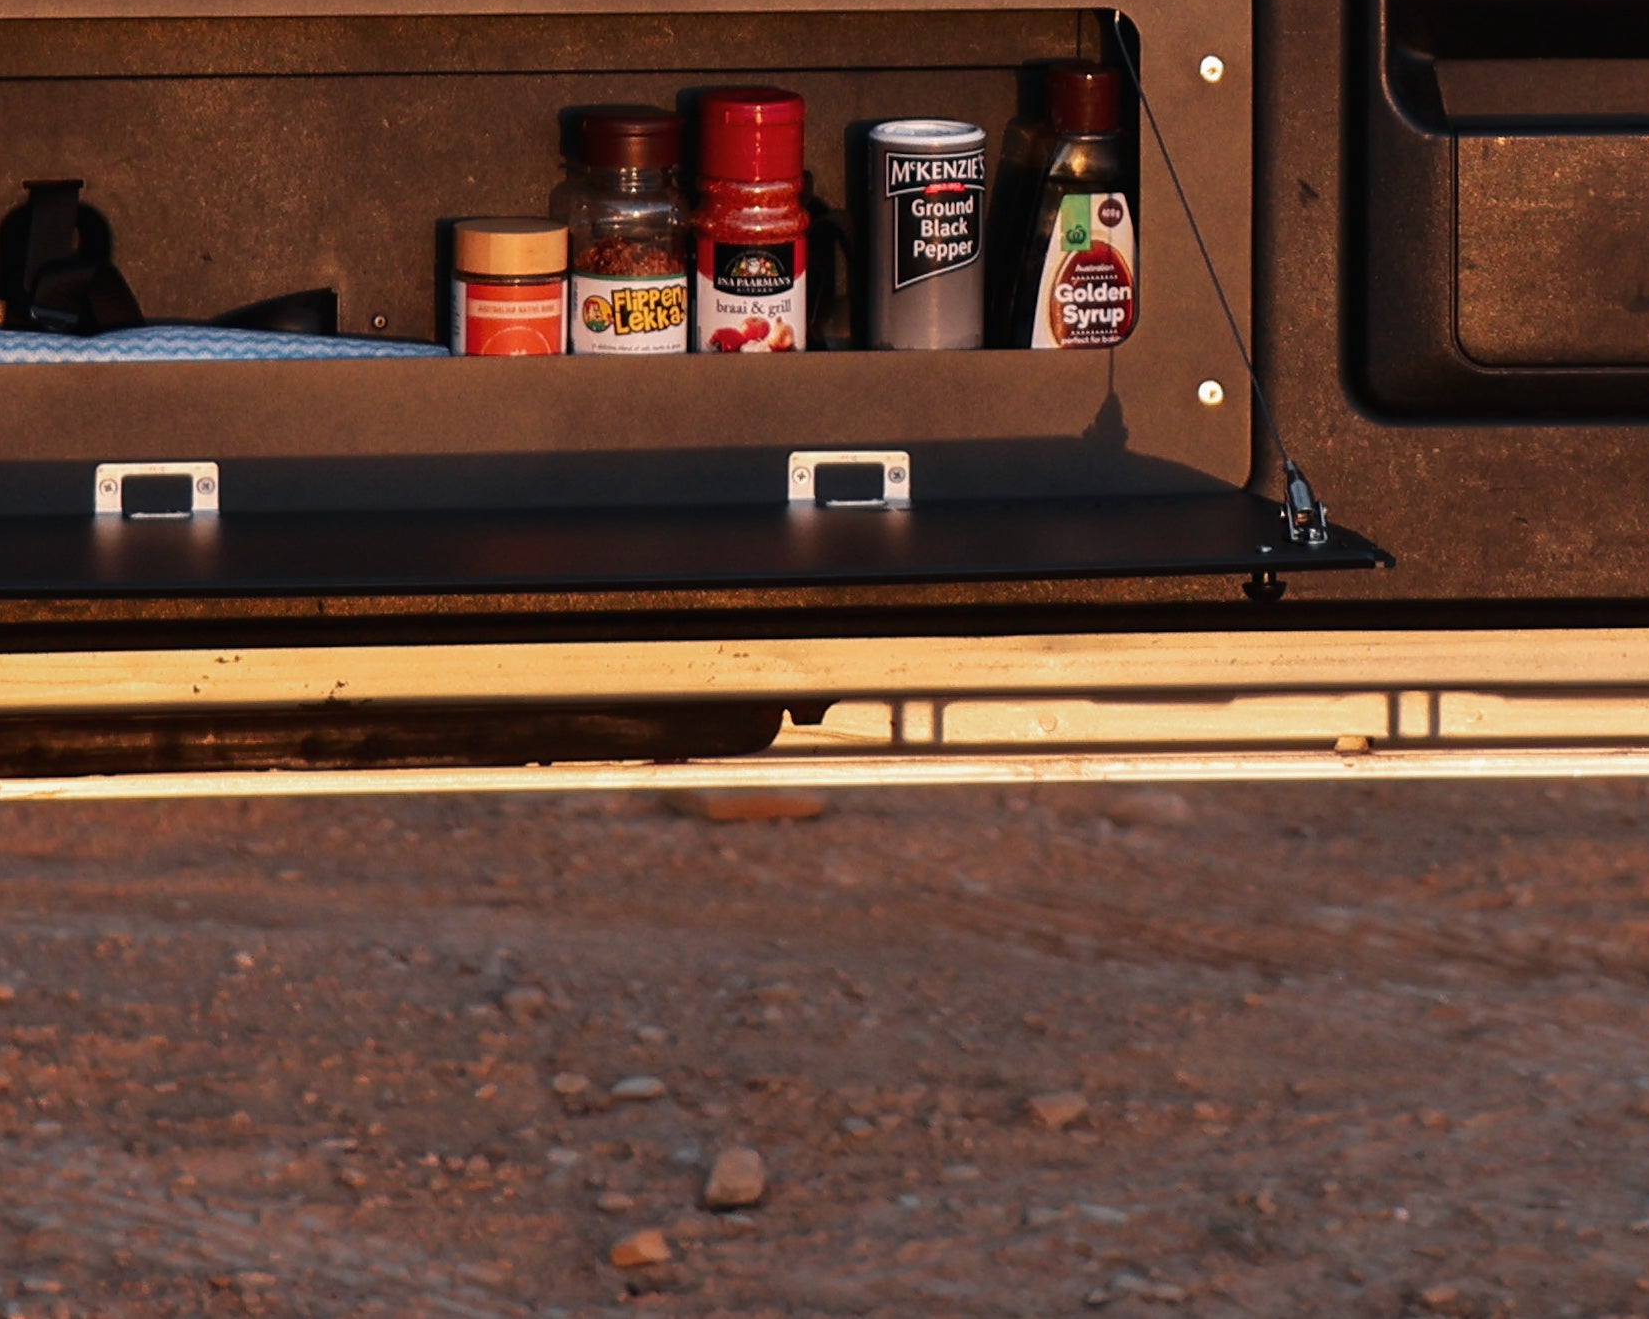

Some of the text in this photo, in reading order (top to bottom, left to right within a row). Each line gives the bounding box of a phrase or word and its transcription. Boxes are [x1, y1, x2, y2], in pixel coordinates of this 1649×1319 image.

[911, 194, 974, 217] Ground
[920, 216, 969, 238] Black
[912, 239, 974, 262] Pepper
[1074, 263, 1115, 273] Australian
[1054, 282, 1133, 303] Golden
[716, 298, 792, 318] braai & grill
[1062, 304, 1126, 329] Syrup
[1061, 335, 1090, 346] perfect
